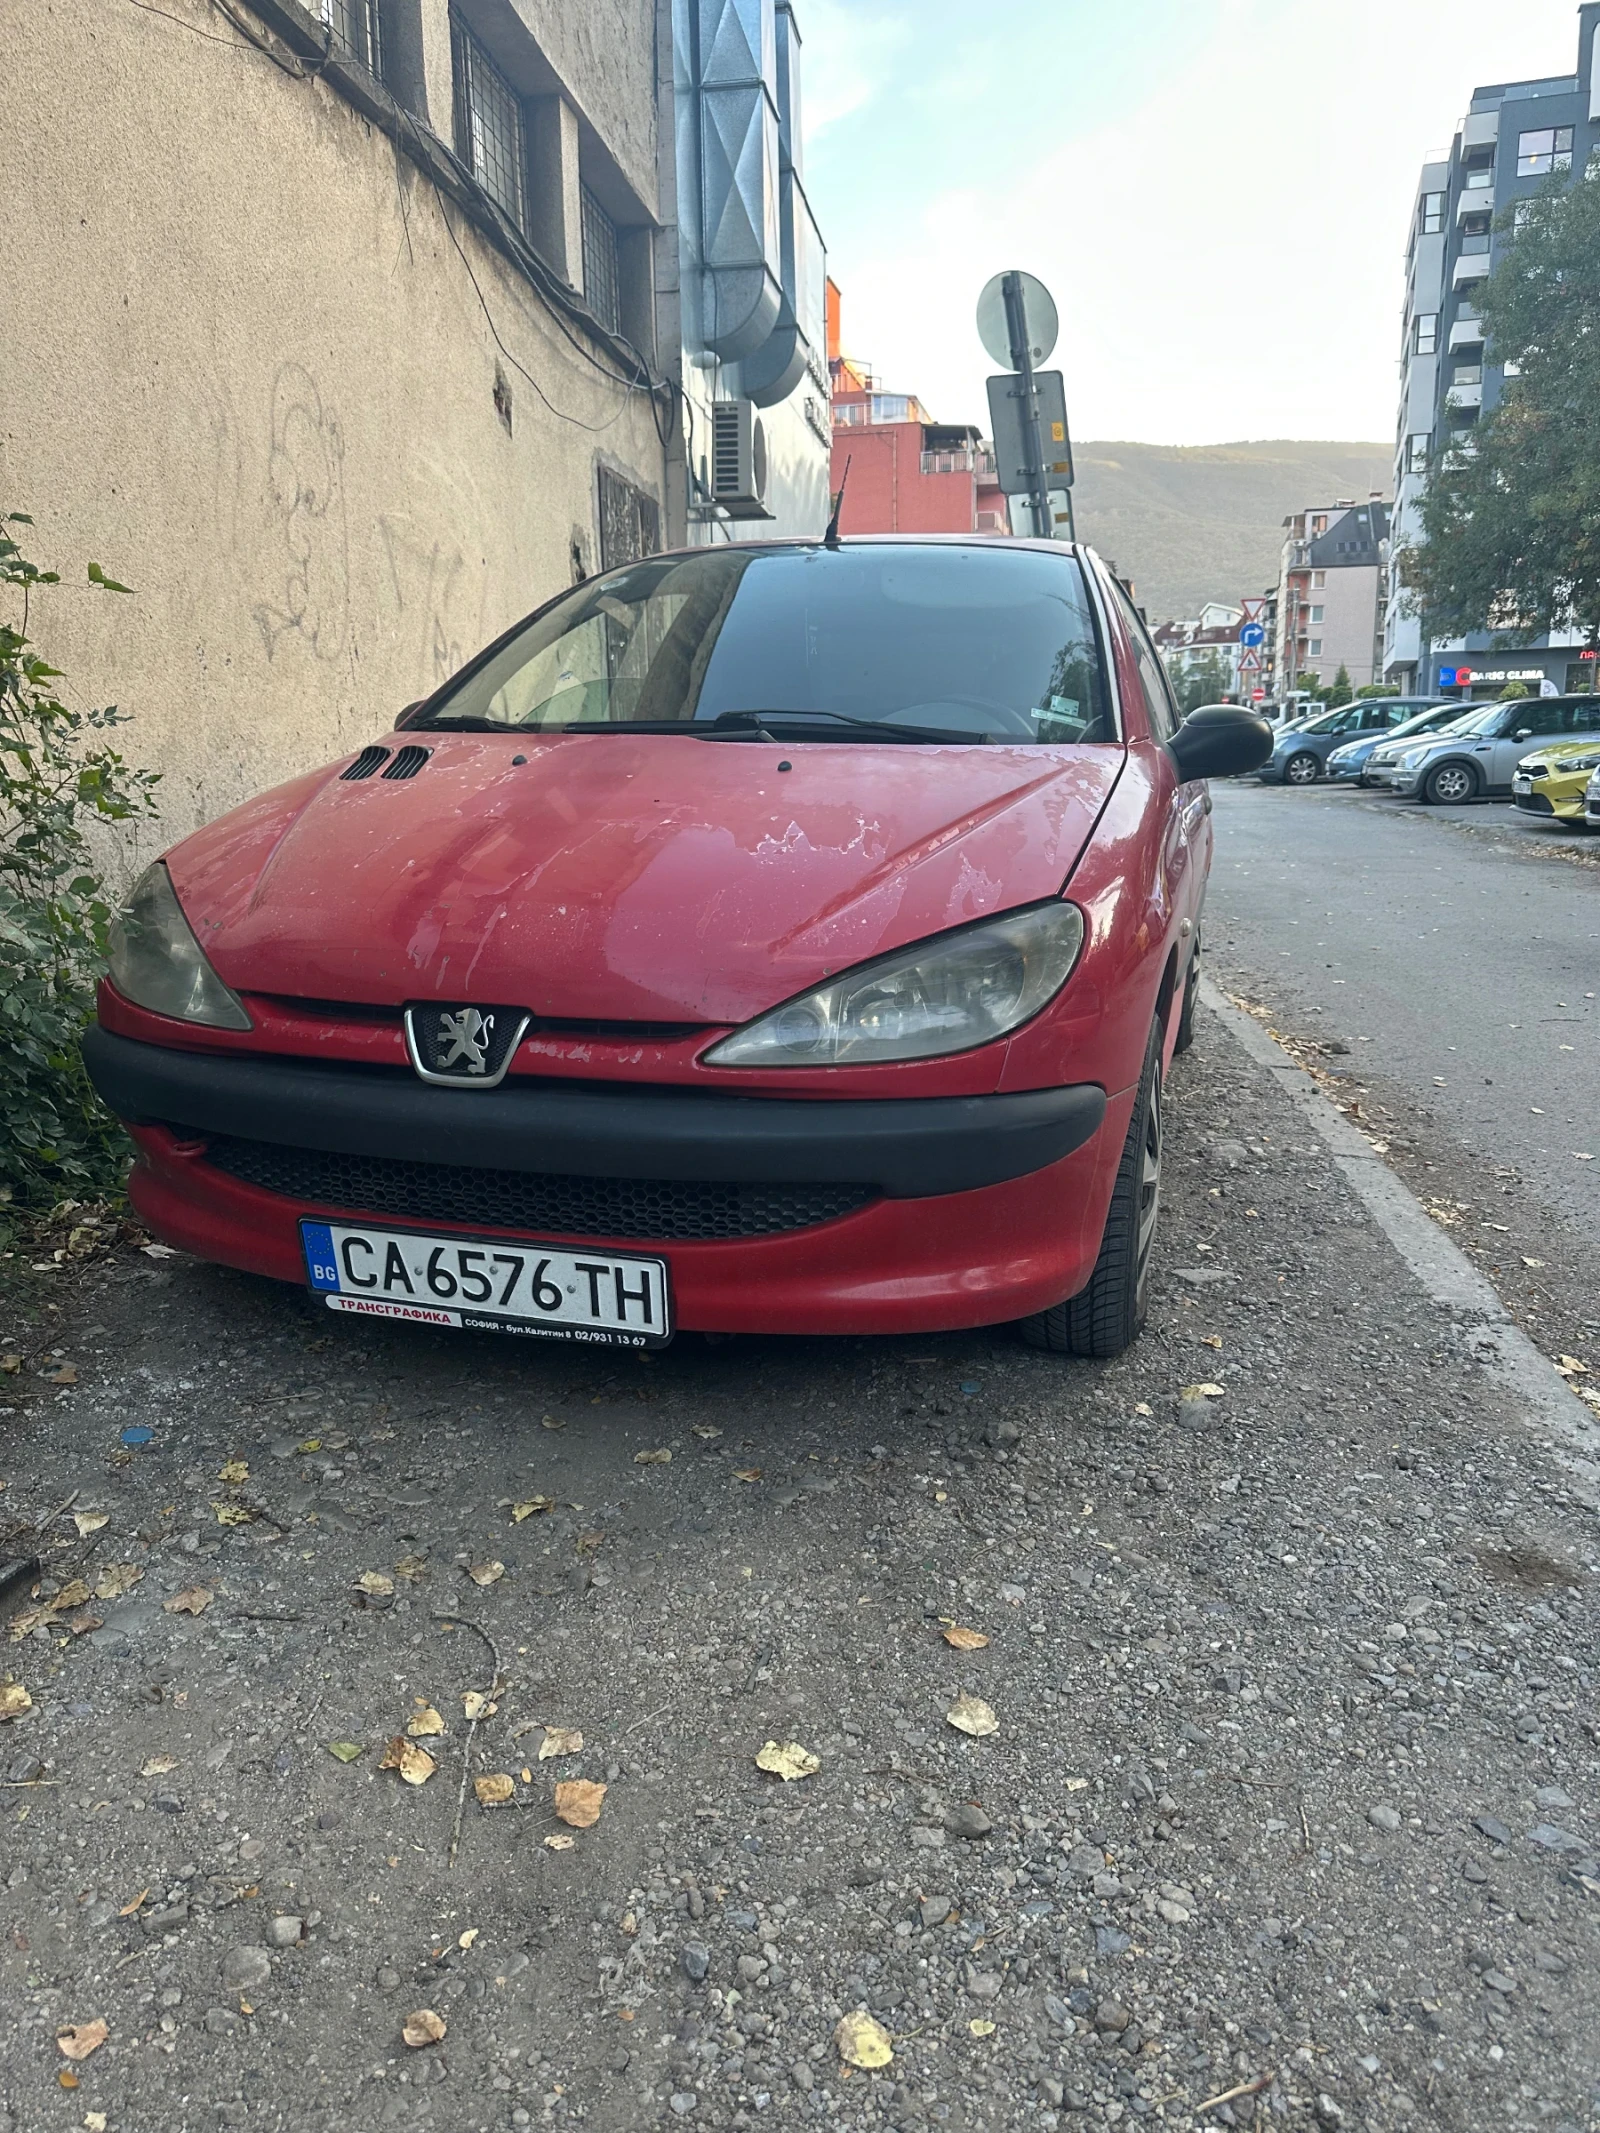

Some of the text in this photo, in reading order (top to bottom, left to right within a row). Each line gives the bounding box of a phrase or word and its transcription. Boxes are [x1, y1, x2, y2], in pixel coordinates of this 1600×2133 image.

[1506, 670, 1545, 680] CLIMA
[313, 1264, 336, 1281] BG
[341, 1236, 653, 1324] CA 6576 TH
[338, 1299, 451, 1324] ТРАНСГРАФИКА
[464, 1318, 499, 1330] СОФИЯ
[574, 1330, 613, 1343] 02/931
[616, 1335, 630, 1345] 13
[632, 1337, 646, 1346] 67
